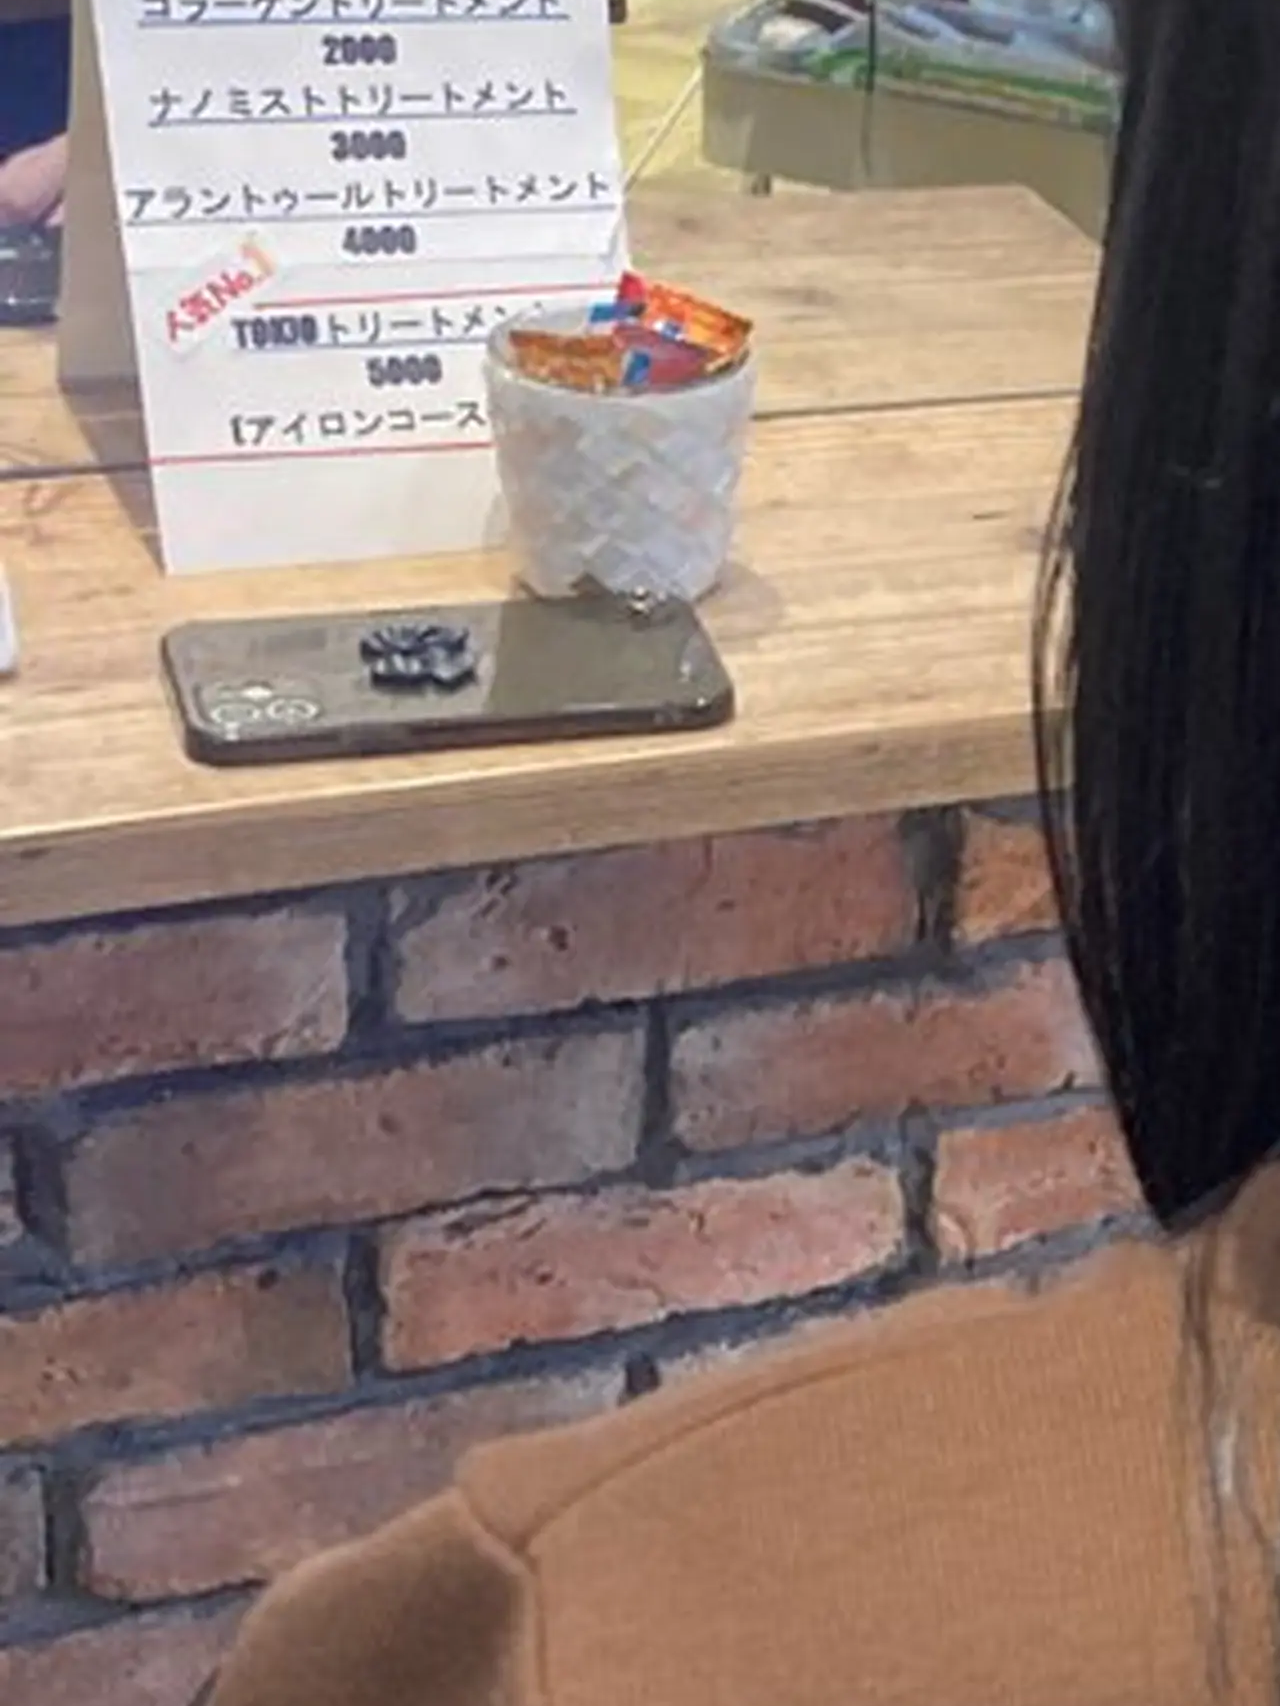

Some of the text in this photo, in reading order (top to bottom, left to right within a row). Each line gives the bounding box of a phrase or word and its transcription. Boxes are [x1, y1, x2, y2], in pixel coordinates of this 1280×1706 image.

[321, 33, 397, 66] 2000
[149, 78, 566, 125] ナノミストトリートメント
[330, 129, 407, 162] 3000
[125, 171, 609, 219] アラントゥールトリートメント
[342, 224, 417, 256] 4000
[365, 354, 443, 387] 5000
